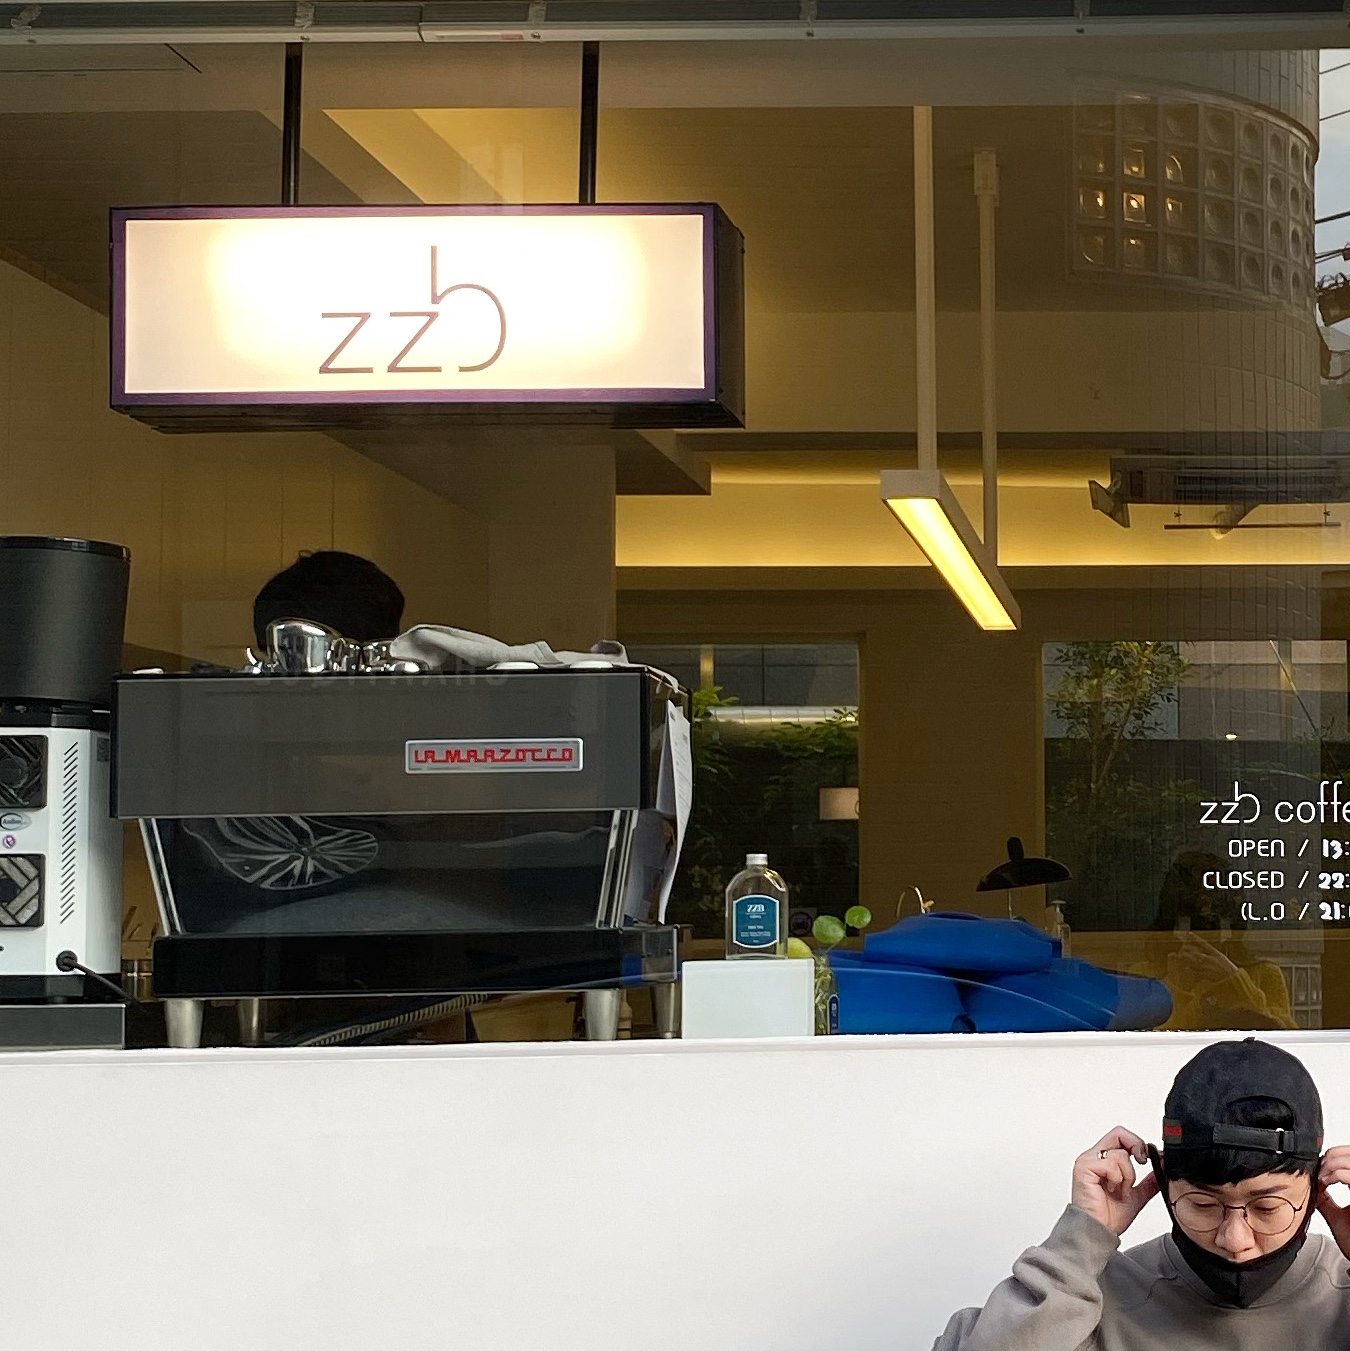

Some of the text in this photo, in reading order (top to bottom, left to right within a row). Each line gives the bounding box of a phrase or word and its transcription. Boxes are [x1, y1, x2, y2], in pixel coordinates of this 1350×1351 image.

[319, 245, 507, 374] zzb
[415, 748, 573, 763] LA MARZOCCO
[1199, 780, 1261, 824] zzb
[1228, 839, 1285, 858] OPEN
[1202, 870, 1285, 890] CLOSED
[1240, 902, 1286, 922] (L.O
